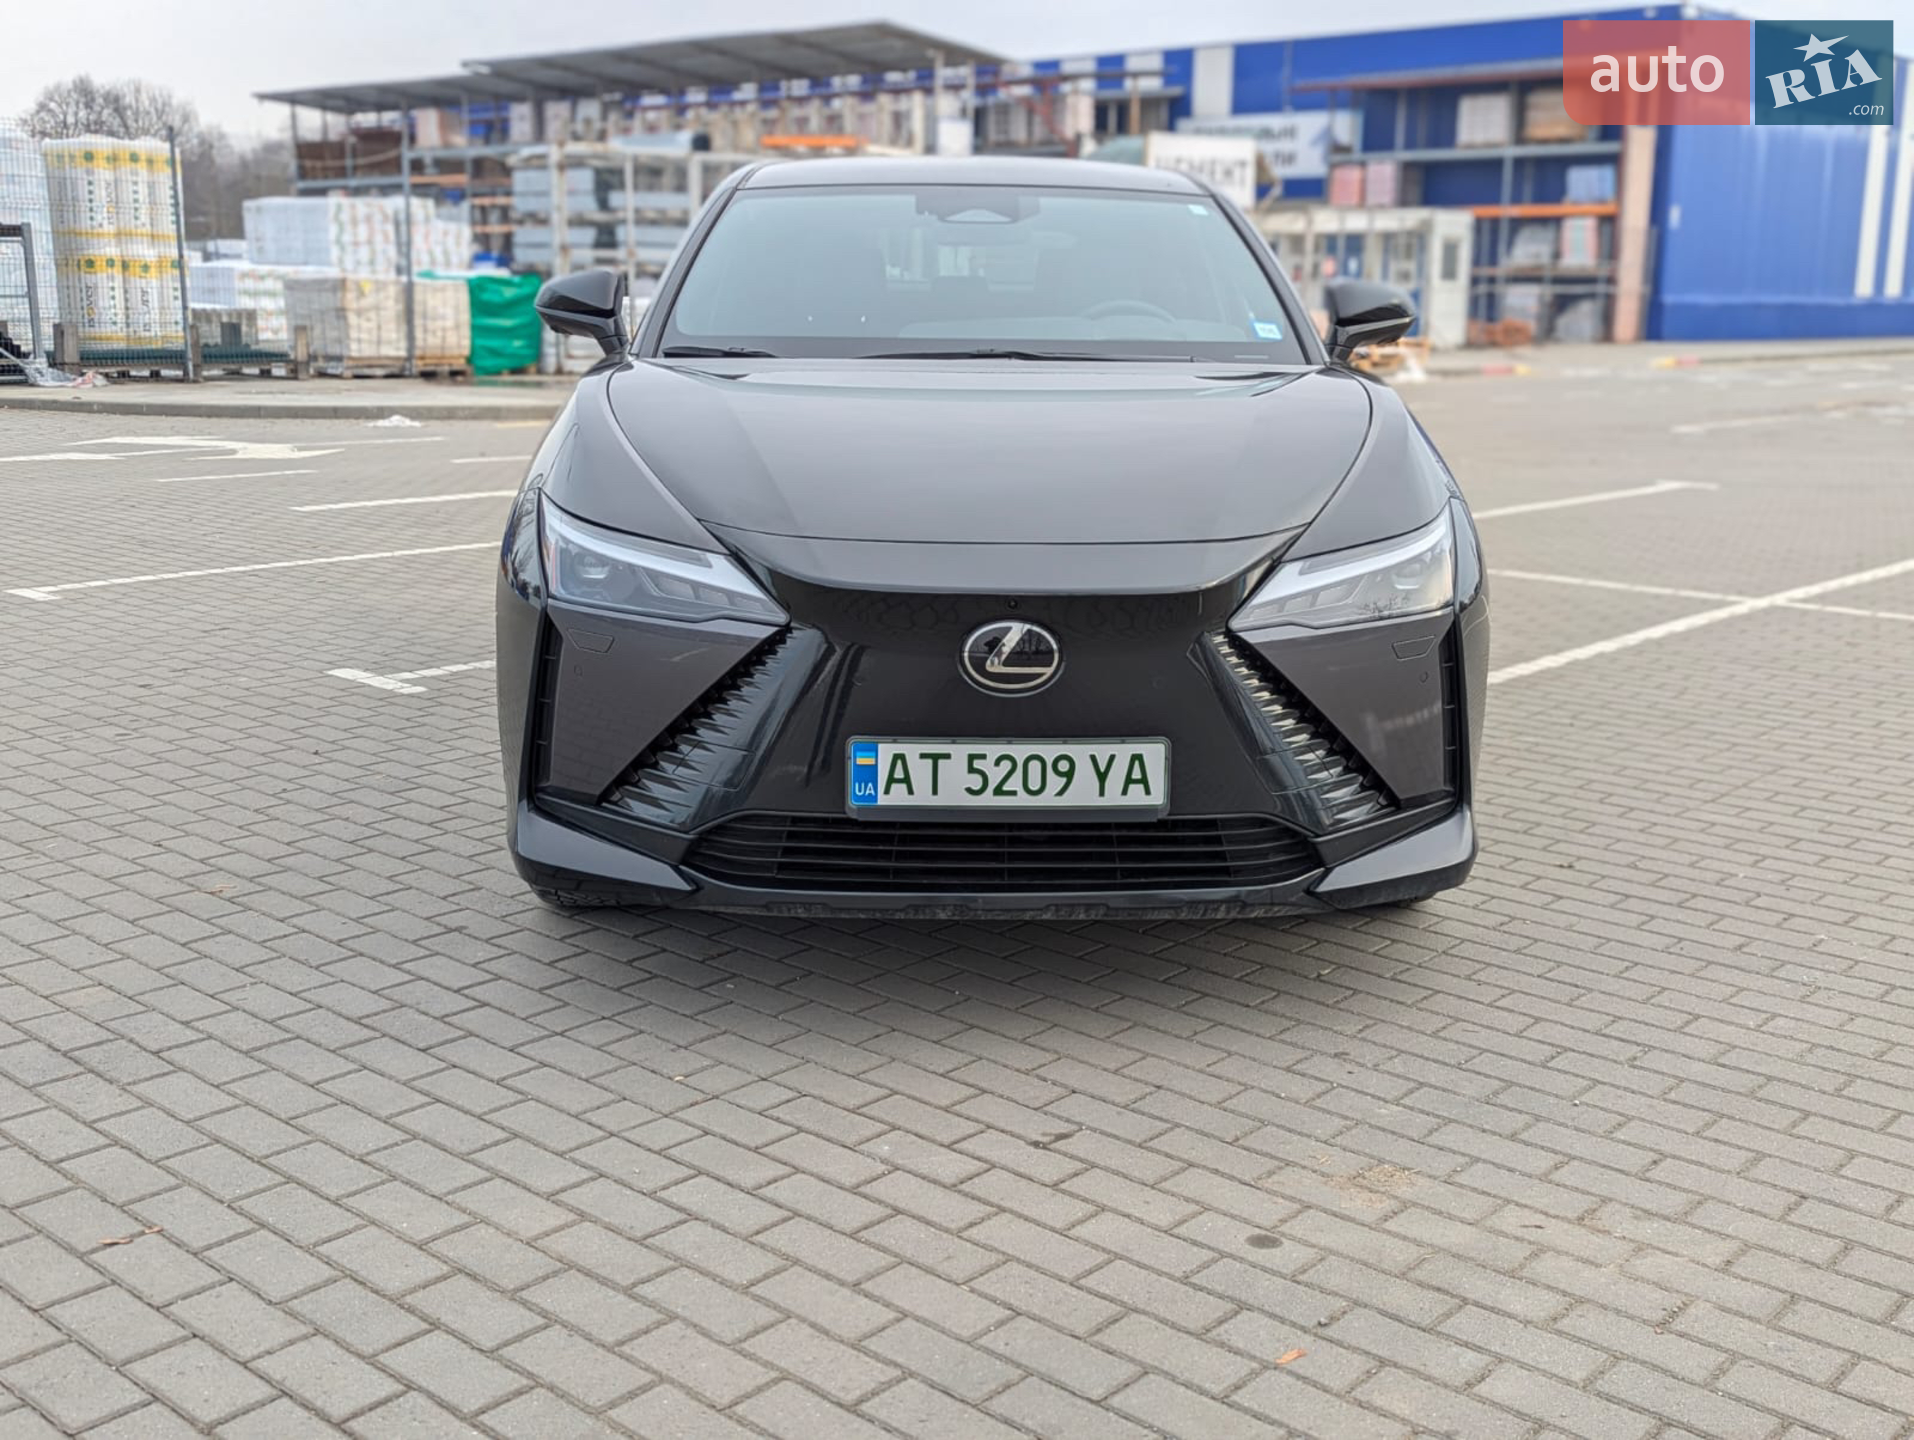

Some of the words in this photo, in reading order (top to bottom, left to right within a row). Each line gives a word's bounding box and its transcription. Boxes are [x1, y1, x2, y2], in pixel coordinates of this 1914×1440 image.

[854, 782, 876, 796] UA
[883, 753, 952, 796] AT
[964, 753, 1076, 797] 5209
[1089, 753, 1152, 797] YA
